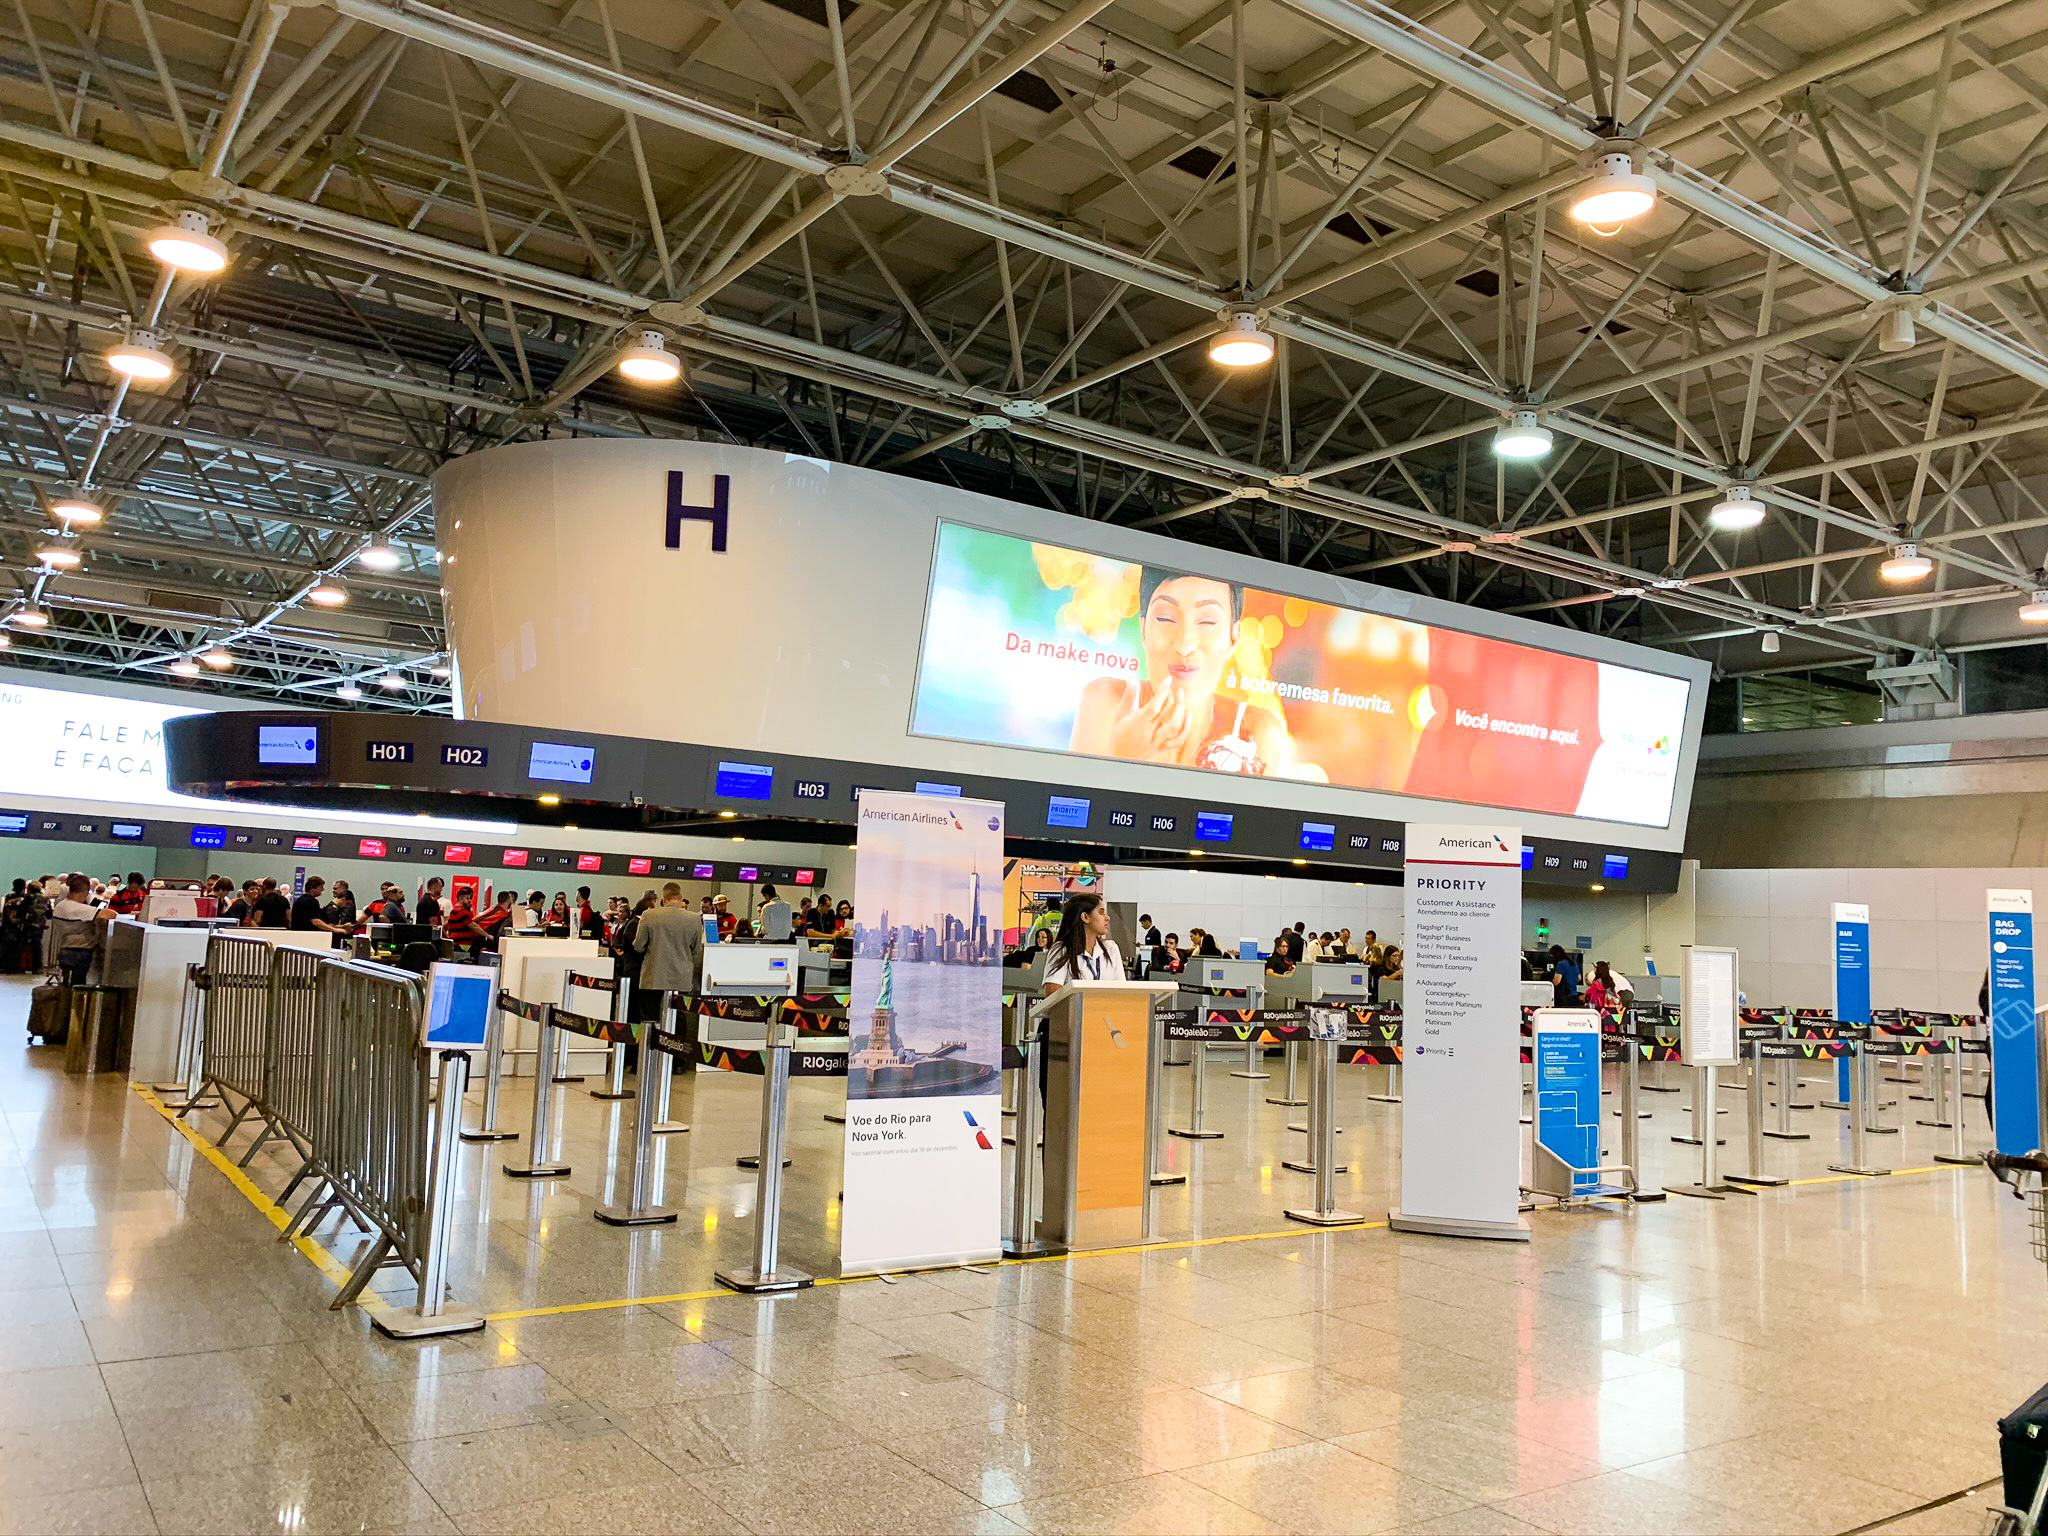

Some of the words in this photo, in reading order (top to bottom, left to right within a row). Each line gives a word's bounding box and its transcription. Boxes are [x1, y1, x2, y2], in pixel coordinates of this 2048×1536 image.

[665, 470, 730, 552] H
[1005, 632, 1031, 653] Da
[1037, 642, 1089, 662] make
[1094, 652, 1139, 671] nova
[1239, 675, 1329, 703] sobremesa
[1332, 687, 1395, 714] favorita.
[64, 720, 128, 743] FALE
[1455, 708, 1489, 729] Você
[1490, 719, 1548, 740] encontra
[1549, 729, 1580, 746] aqui.
[372, 744, 405, 760] H01
[447, 748, 482, 764] H02
[54, 750, 67, 767] E
[82, 753, 153, 778] FAÇA
[798, 782, 825, 797] H03
[1051, 806, 1079, 814] PRIORITY
[862, 808, 911, 822] American
[912, 811, 948, 826] Airlines
[1112, 812, 1133, 826] H05
[1153, 817, 1174, 830] H06
[1350, 836, 1368, 848] H07
[1382, 840, 1400, 852] H08
[1439, 838, 1492, 849] American
[1545, 856, 1560, 867] H09
[1573, 859, 1588, 869] H10
[1417, 878, 1486, 891] PRIORITY
[1417, 898, 1454, 907] Customer
[1456, 900, 1496, 909] Assistance
[1417, 908, 1458, 917] Atendimento
[1995, 920, 2015, 928] BAG
[1995, 928, 2022, 936] DROP
[1416, 952, 1442, 960] Business
[1448, 954, 1478, 962] Executiva
[1445, 964, 1473, 972] Economy
[1425, 999, 1454, 1007] Executive
[1264, 1012, 1294, 1020] RIOgaleão
[1425, 1018, 1452, 1026] Platinum
[1170, 1026, 1208, 1037] RIOgaleão
[1425, 1028, 1440, 1036] Gold
[1426, 1047, 1446, 1055] Priority
[852, 1115, 872, 1126] Voe
[874, 1114, 888, 1125] do
[890, 1113, 907, 1124] Rio
[909, 1114, 932, 1126] para
[852, 1131, 879, 1142] Nova
